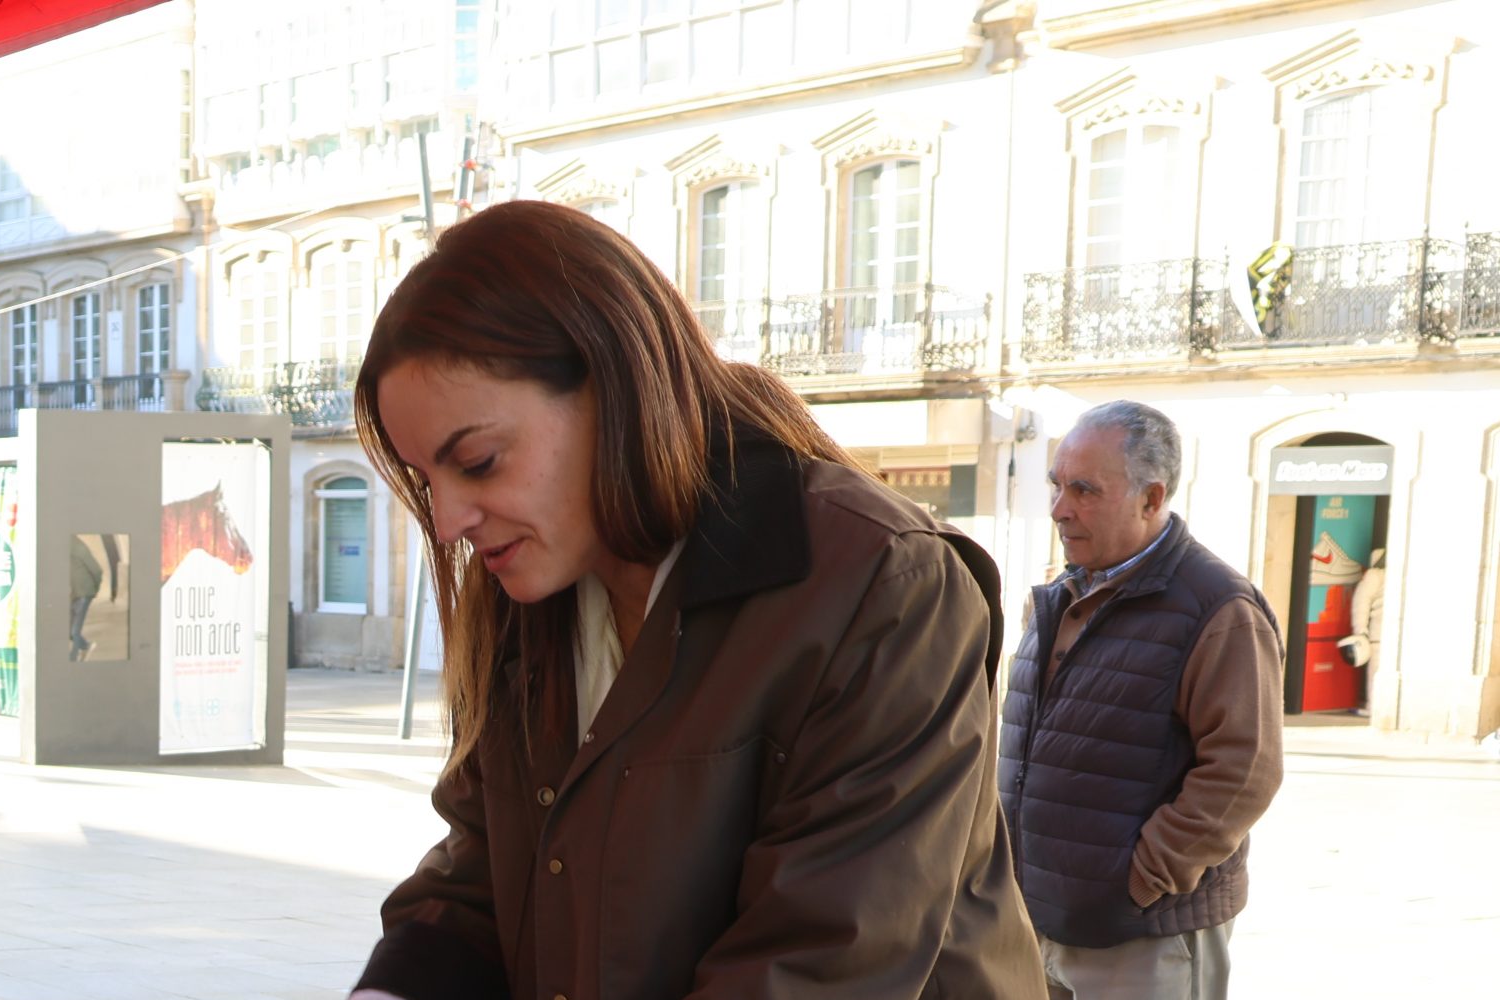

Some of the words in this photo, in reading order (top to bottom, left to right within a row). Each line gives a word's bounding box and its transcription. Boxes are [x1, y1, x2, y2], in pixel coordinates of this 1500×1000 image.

[175, 586, 183, 619] o
[188, 586, 215, 622] que
[175, 624, 203, 657] non
[208, 621, 242, 656] arde
